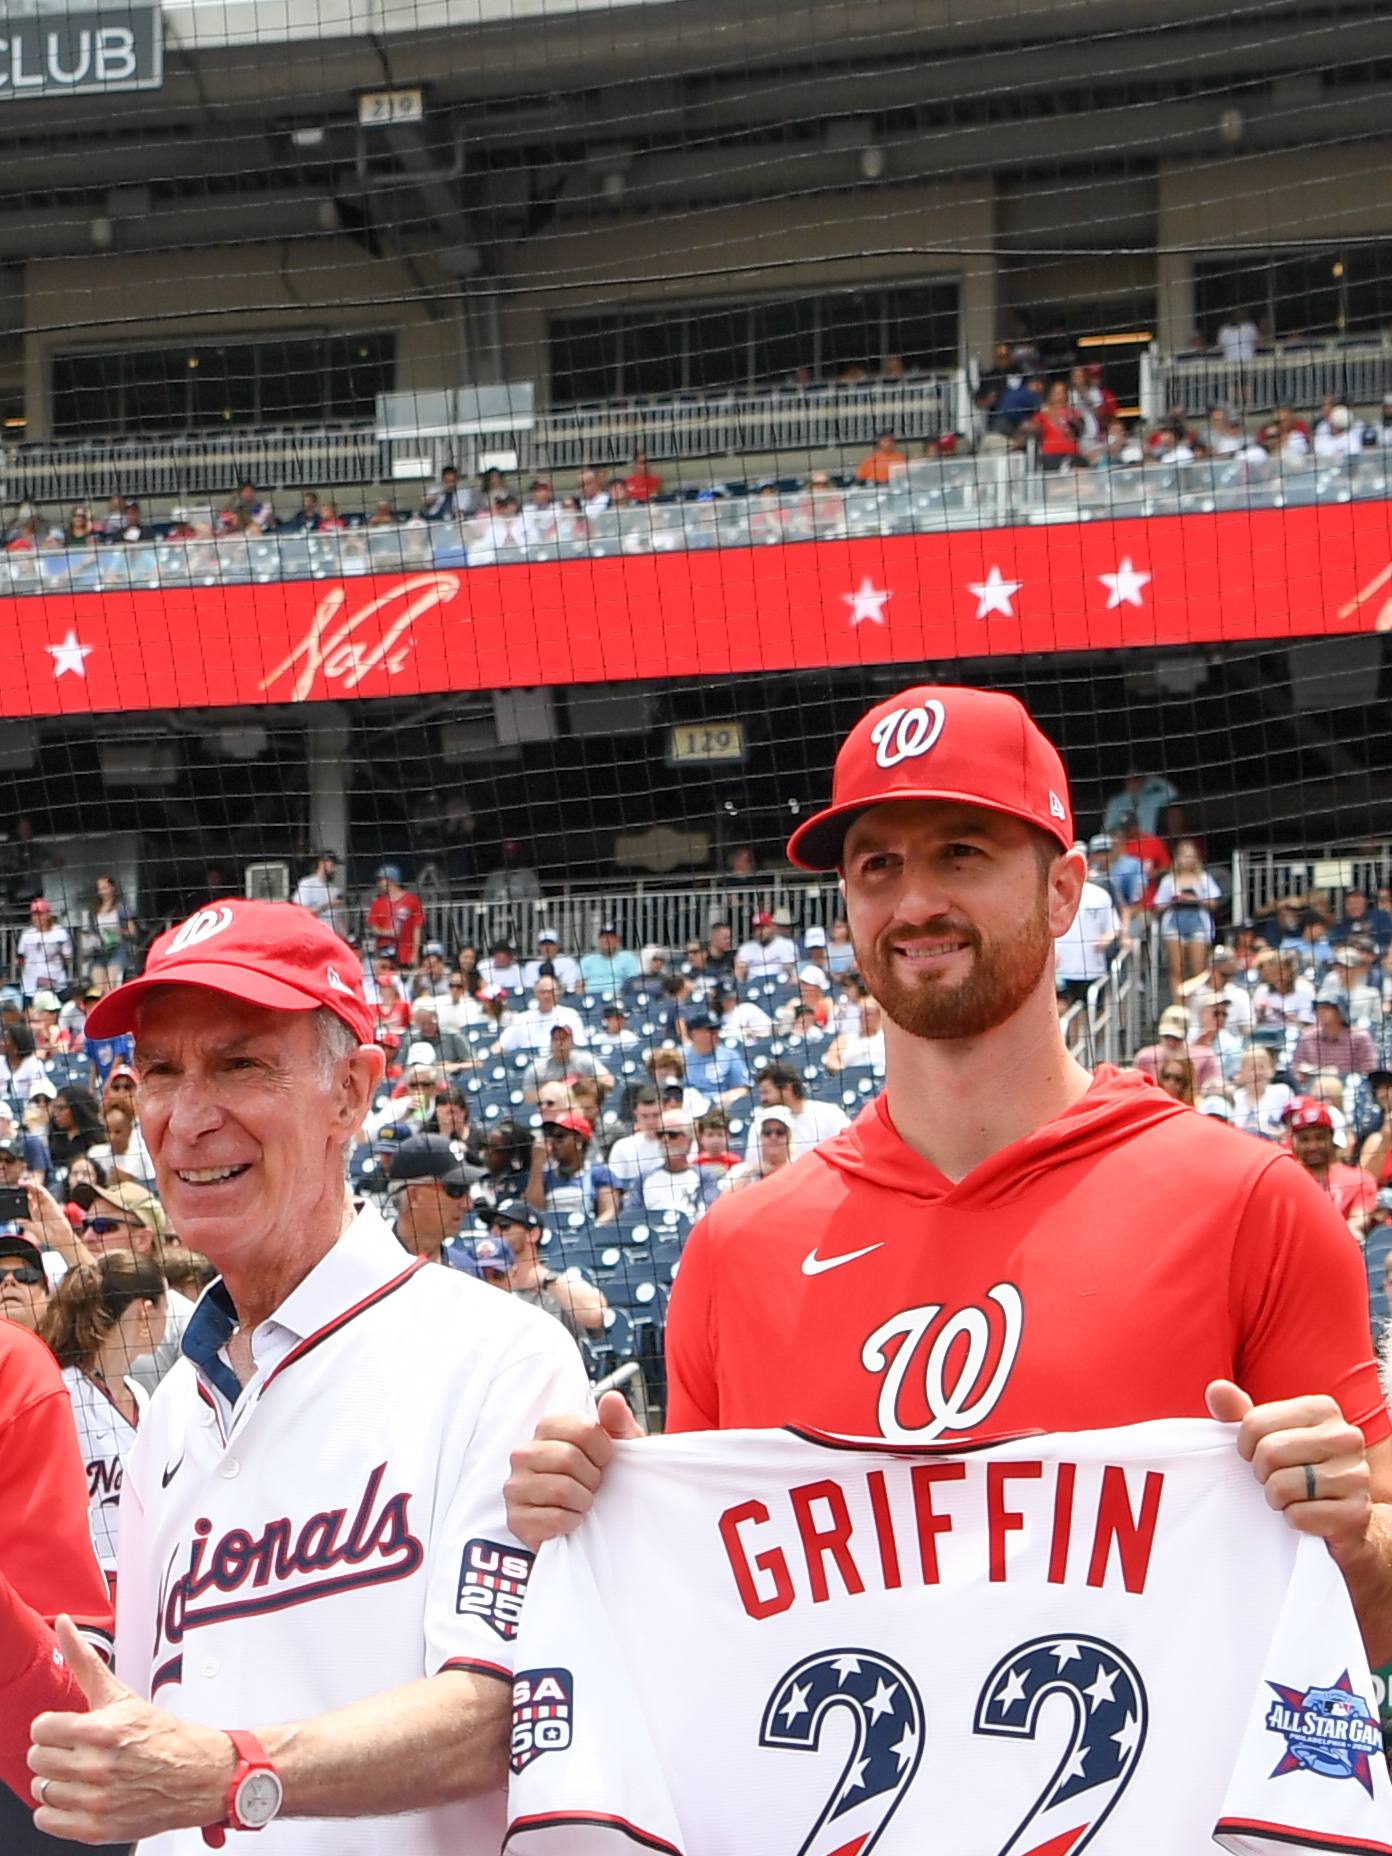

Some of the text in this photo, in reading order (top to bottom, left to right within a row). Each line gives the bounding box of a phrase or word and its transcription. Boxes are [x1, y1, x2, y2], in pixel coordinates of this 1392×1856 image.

[718, 1461, 1165, 1621] GRIFFIN
[470, 1546, 529, 1580] US
[459, 1585, 522, 1624] 25
[513, 1677, 566, 1708] SA
[512, 1719, 570, 1756] 50
[1268, 1704, 1383, 1752] ALL STAR GAM
